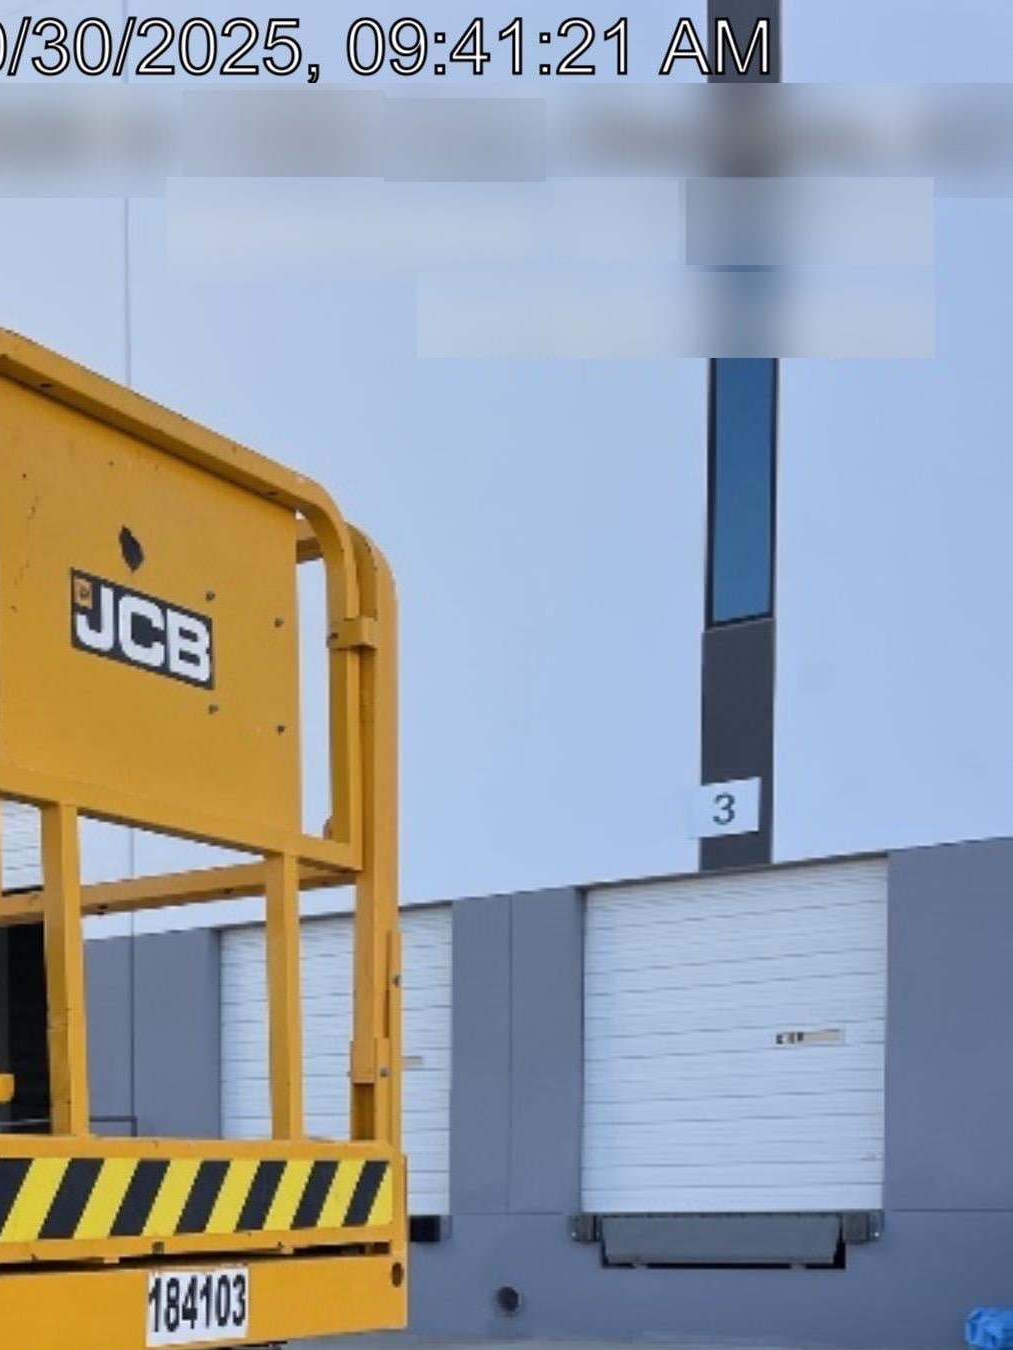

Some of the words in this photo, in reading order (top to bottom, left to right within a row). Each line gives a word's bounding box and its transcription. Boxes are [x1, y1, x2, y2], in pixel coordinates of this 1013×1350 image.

[76, 585, 210, 682] JCB
[713, 793, 735, 825] 3
[149, 1274, 245, 1333] 184103
